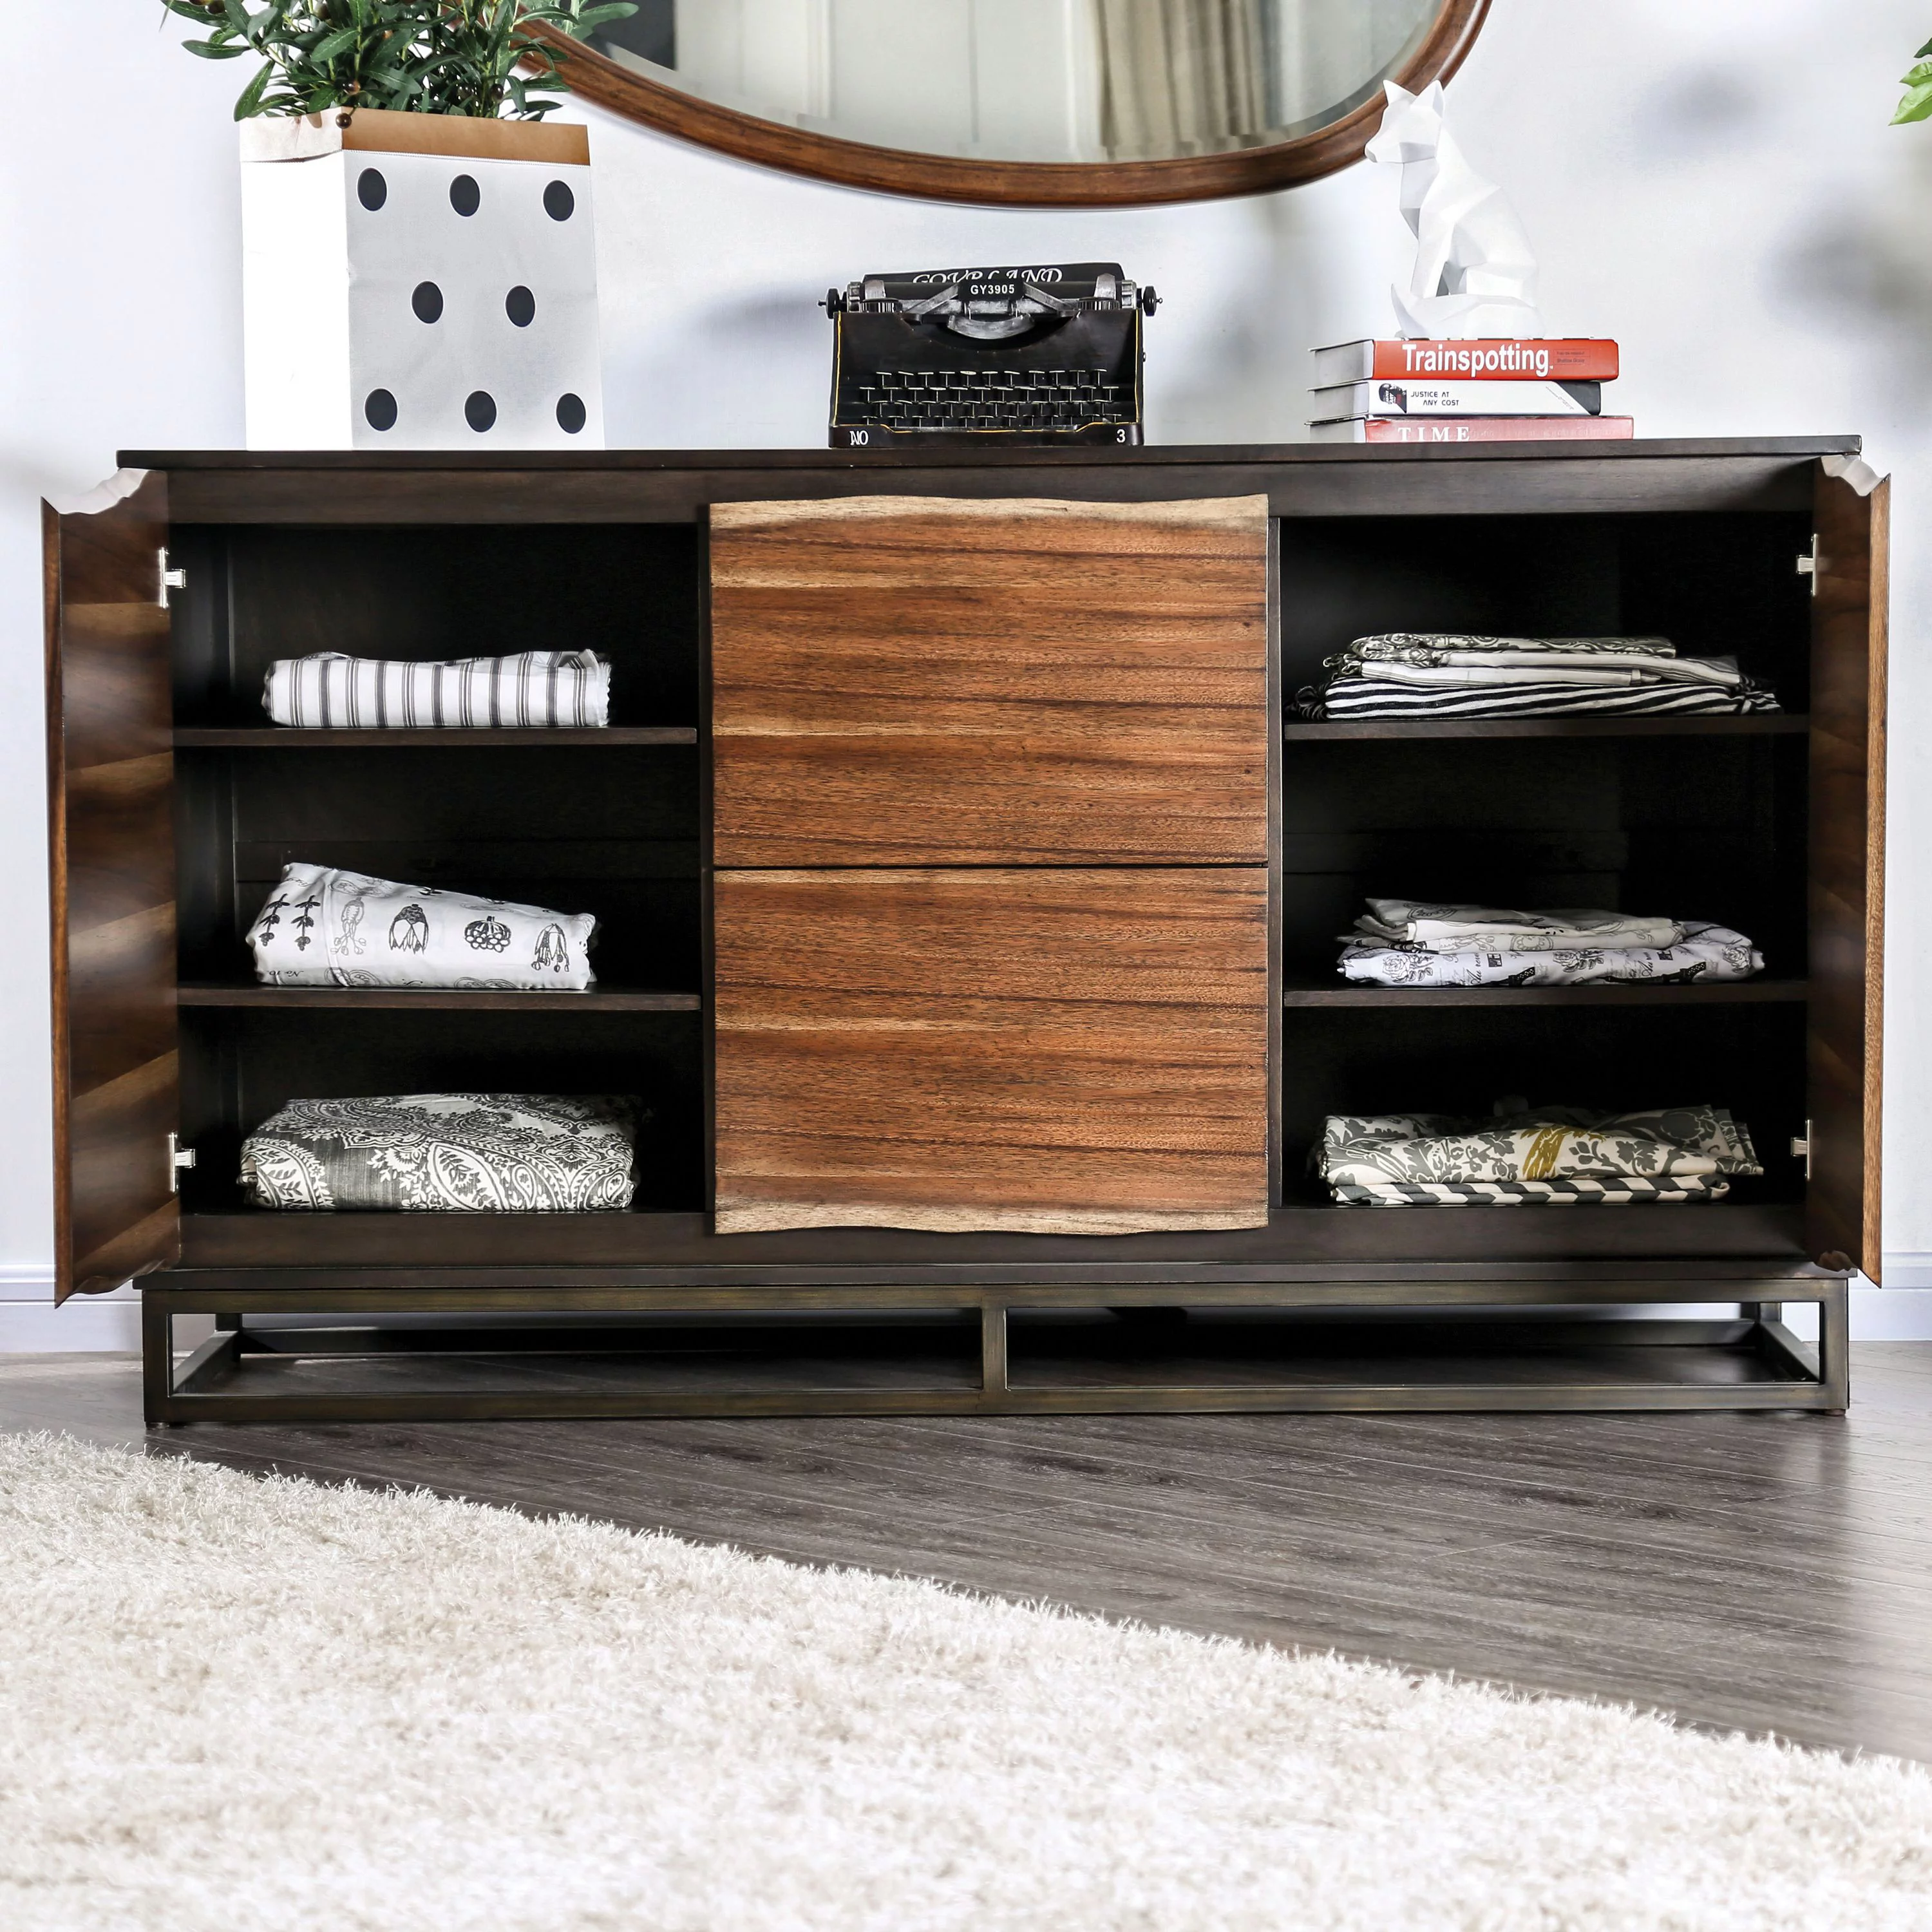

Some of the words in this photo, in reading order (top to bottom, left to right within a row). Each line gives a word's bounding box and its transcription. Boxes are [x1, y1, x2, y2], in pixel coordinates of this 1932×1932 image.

[970, 284, 1015, 295] GY3905
[849, 430, 869, 445] NO
[1116, 428, 1126, 443] 3
[1398, 426, 1470, 442] TIME
